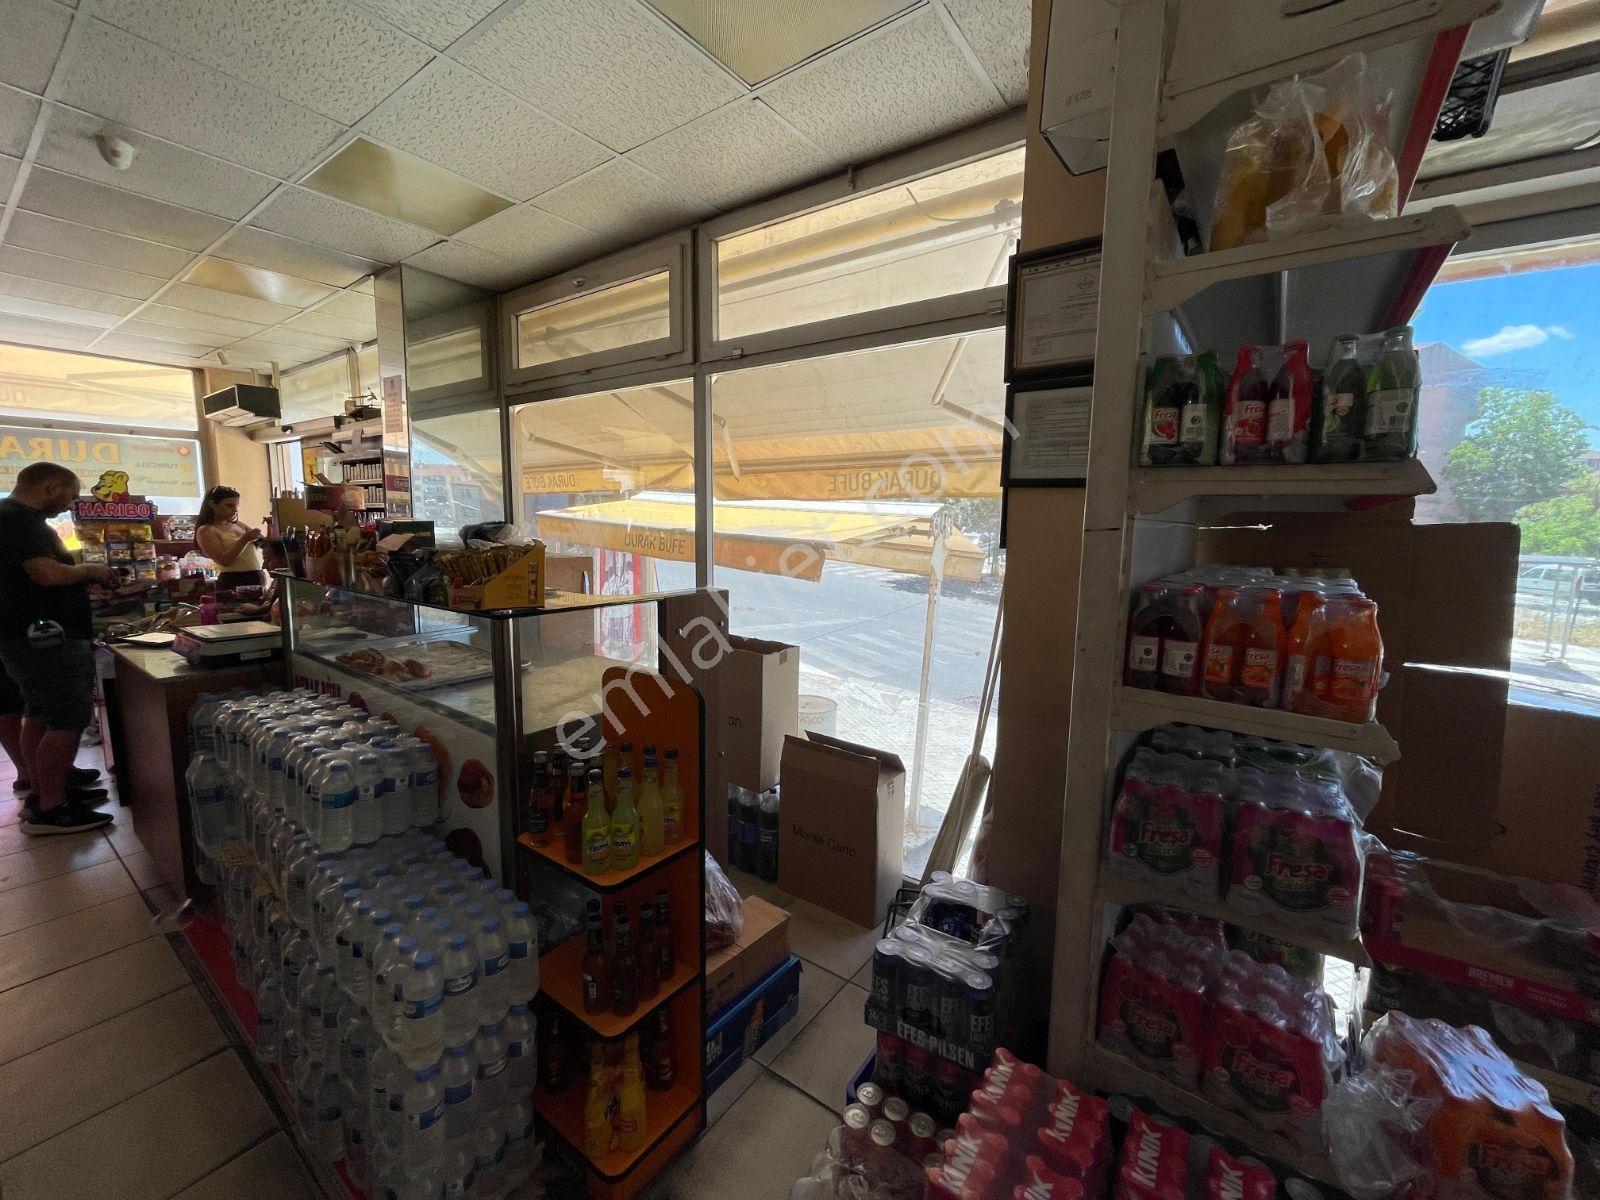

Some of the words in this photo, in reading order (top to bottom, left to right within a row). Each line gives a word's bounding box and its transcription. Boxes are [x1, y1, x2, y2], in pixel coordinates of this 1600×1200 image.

[79, 502, 151, 518] HARIBO
[624, 531, 657, 551] DURAK
[658, 535, 687, 555] BUFE
[1044, 1087, 1081, 1143] KINIK
[938, 1129, 983, 1196] KINIK
[1131, 1120, 1163, 1189] KINIK
